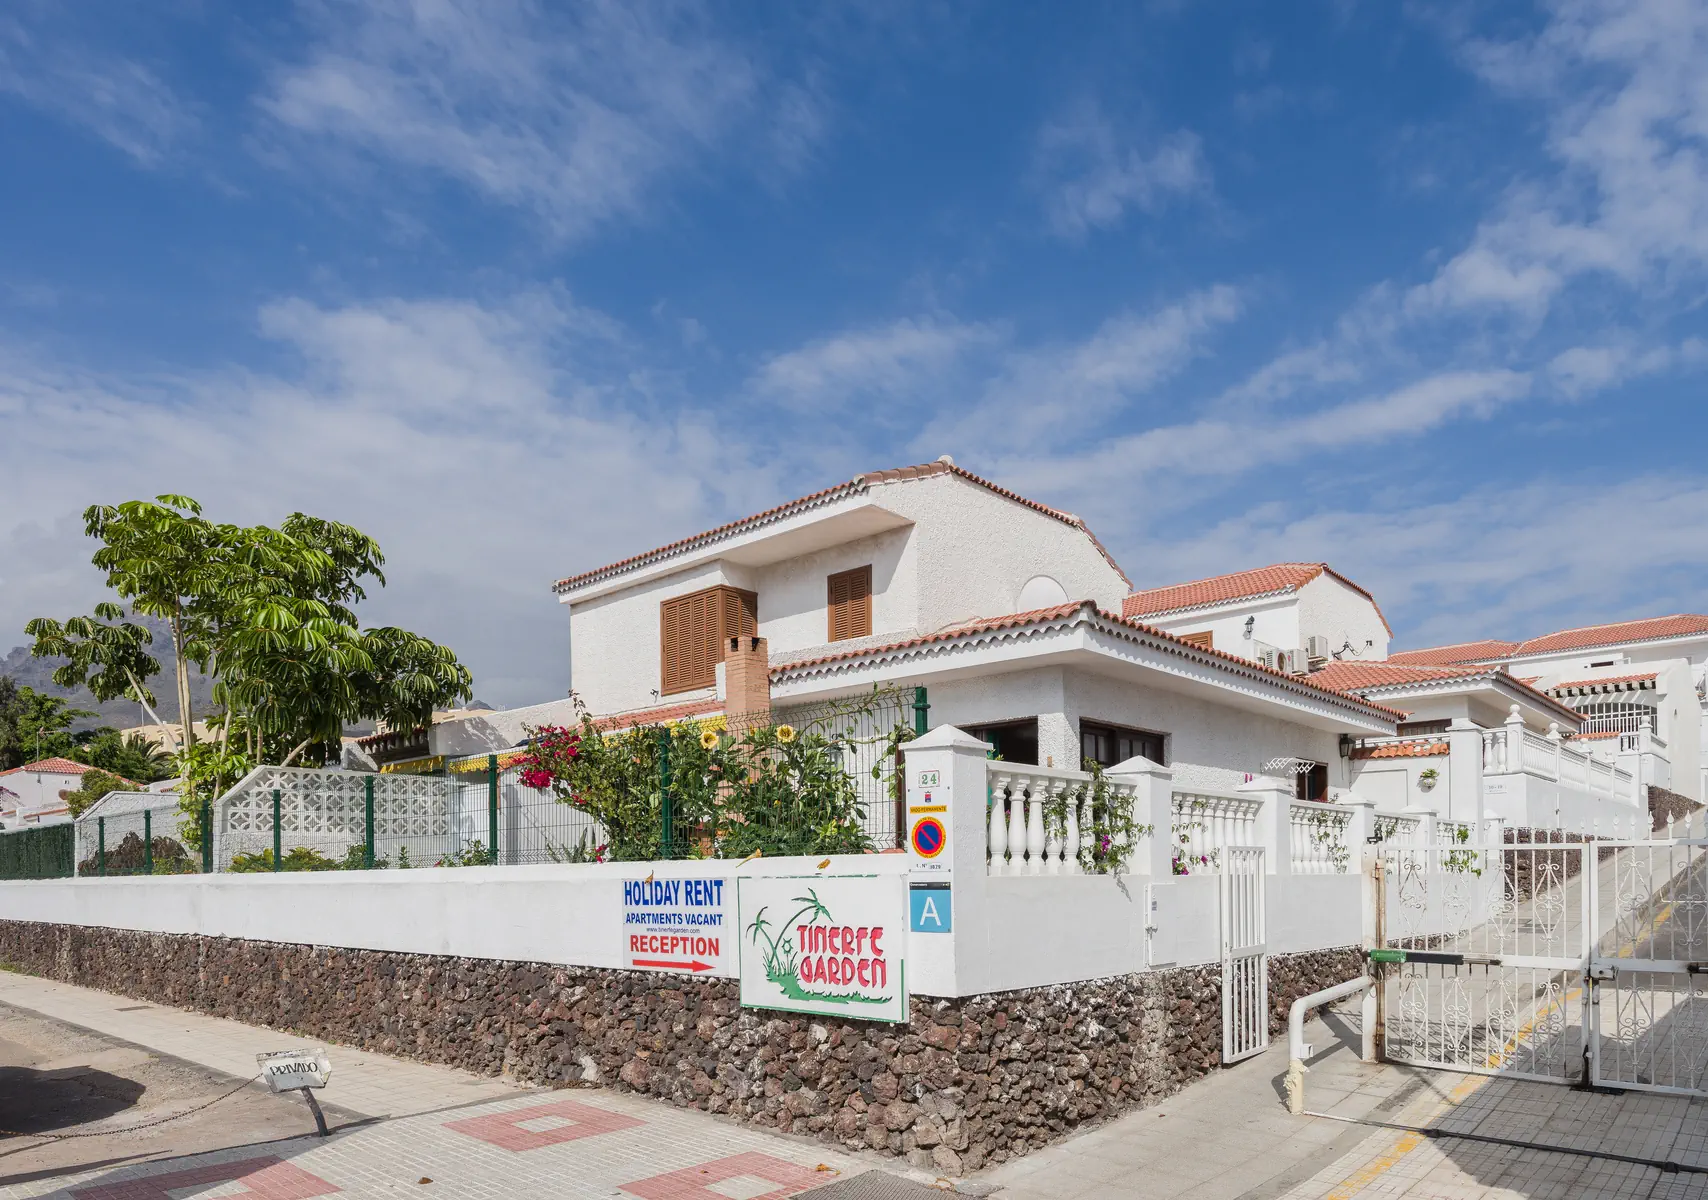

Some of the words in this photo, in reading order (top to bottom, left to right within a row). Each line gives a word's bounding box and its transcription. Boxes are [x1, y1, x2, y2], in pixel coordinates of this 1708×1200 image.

[921, 774, 937, 785] 24
[624, 880, 680, 906] HOLIDAY
[684, 879, 723, 906] RENT
[625, 912, 683, 925] APARTMENTS
[684, 913, 723, 925] VACANT
[919, 896, 942, 926] A
[629, 934, 720, 957] RECEPTION
[800, 955, 887, 989] GARDEN
[269, 1062, 318, 1076] PRIVADO
